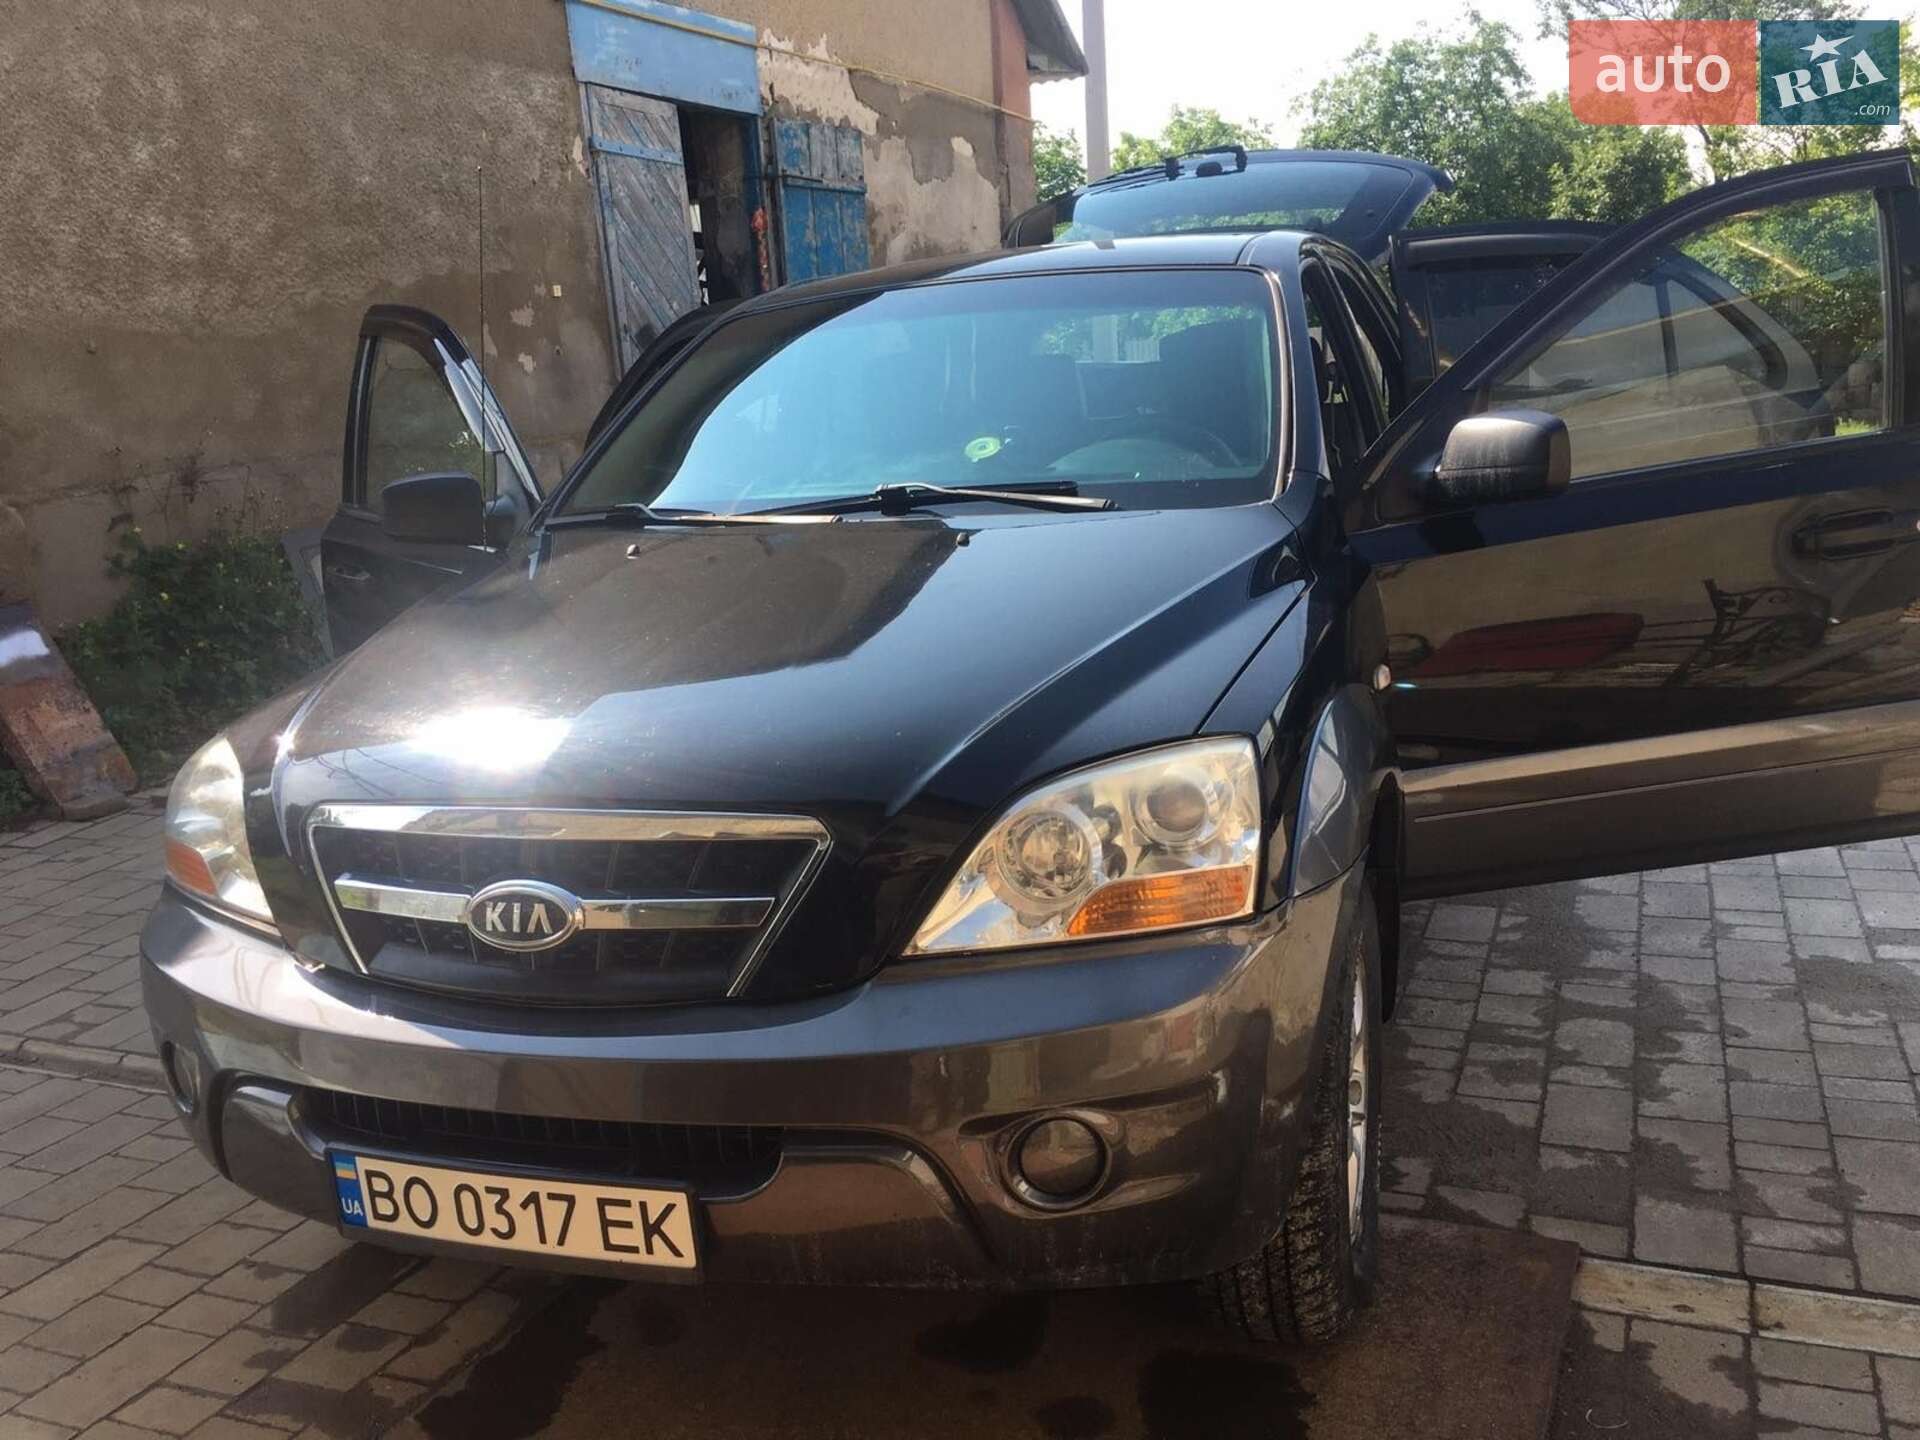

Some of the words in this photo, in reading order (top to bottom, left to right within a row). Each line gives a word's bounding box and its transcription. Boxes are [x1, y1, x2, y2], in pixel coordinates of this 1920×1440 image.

[484, 901, 554, 934] KIA
[340, 1197, 364, 1217] UA
[364, 1168, 438, 1229] BO
[453, 1183, 576, 1247] 0317
[596, 1197, 685, 1258] EK
